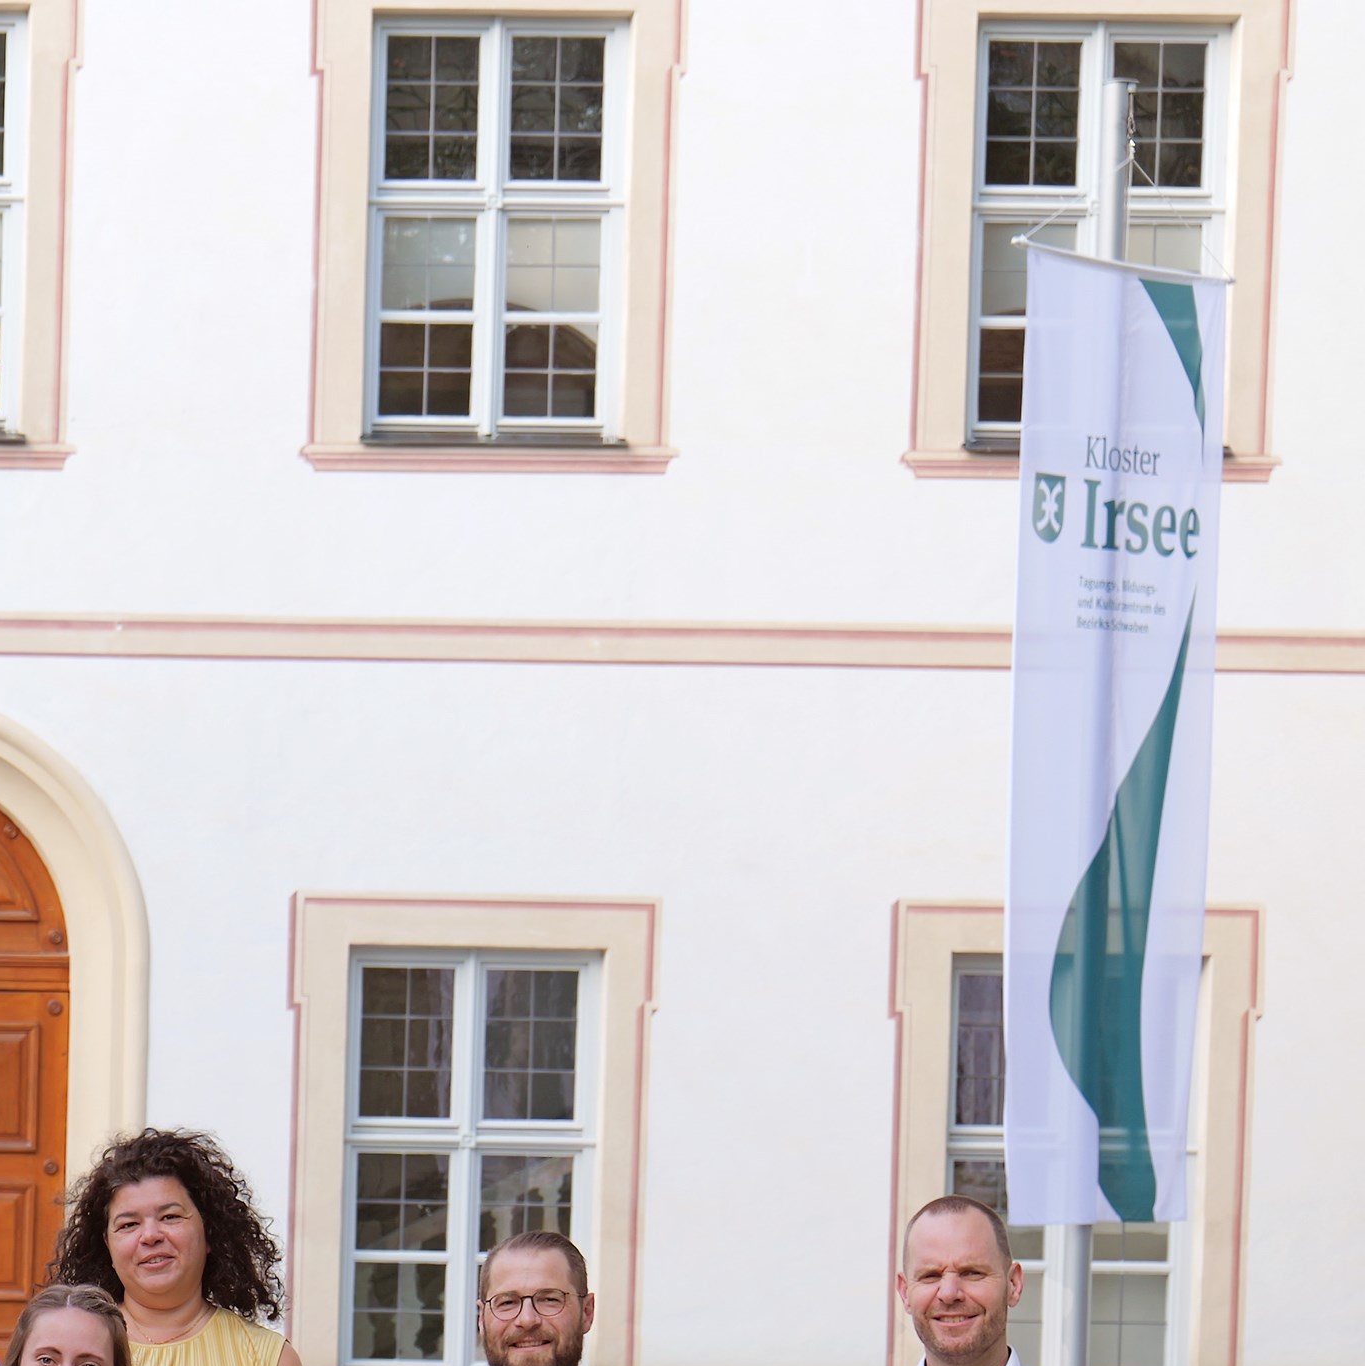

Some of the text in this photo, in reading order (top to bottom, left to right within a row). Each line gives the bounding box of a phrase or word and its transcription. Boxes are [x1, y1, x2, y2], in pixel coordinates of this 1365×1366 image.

[1085, 435, 1160, 476] Kloster
[1080, 478, 1200, 559] Irsee
[1077, 597, 1093, 609] und
